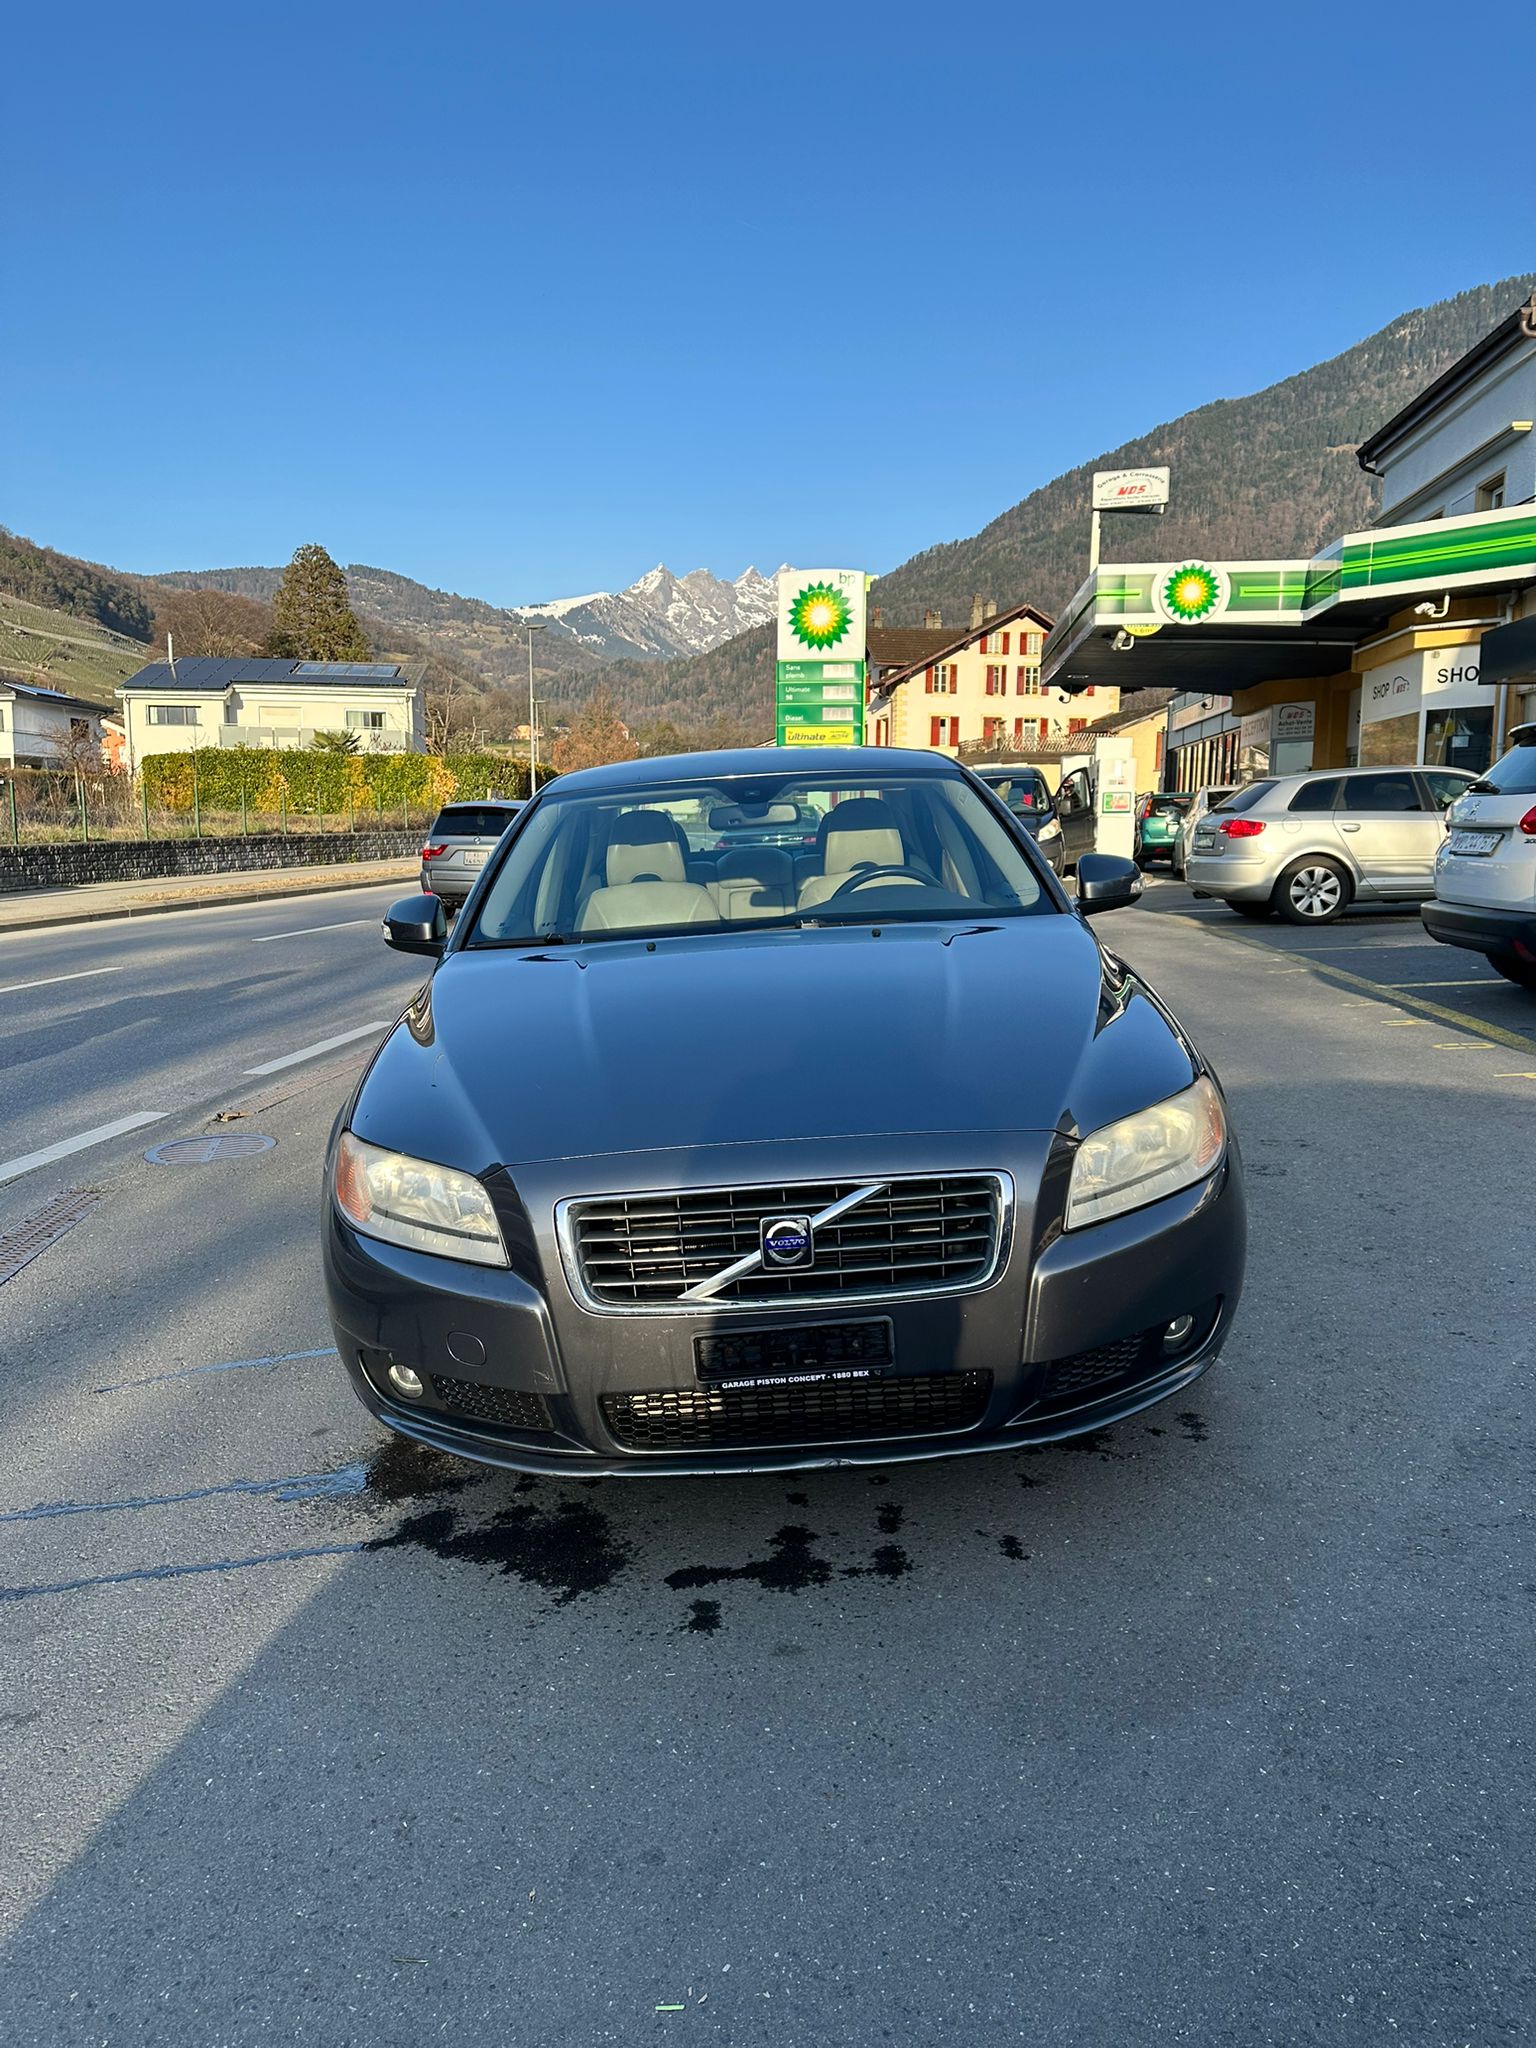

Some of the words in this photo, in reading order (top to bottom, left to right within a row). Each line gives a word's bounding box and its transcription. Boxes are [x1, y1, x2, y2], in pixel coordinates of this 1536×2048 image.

[1097, 475, 1121, 488] Garage
[839, 572, 856, 586] bp
[1372, 682, 1390, 701] SHOP
[787, 732, 826, 741] ultimate
[769, 1239, 805, 1247] VOLVO
[721, 1380, 755, 1389] GARAGE
[756, 1377, 787, 1386] PISTON
[788, 1374, 826, 1384] CONCEPT
[832, 1372, 851, 1380] 1880
[852, 1369, 870, 1378] BEX
